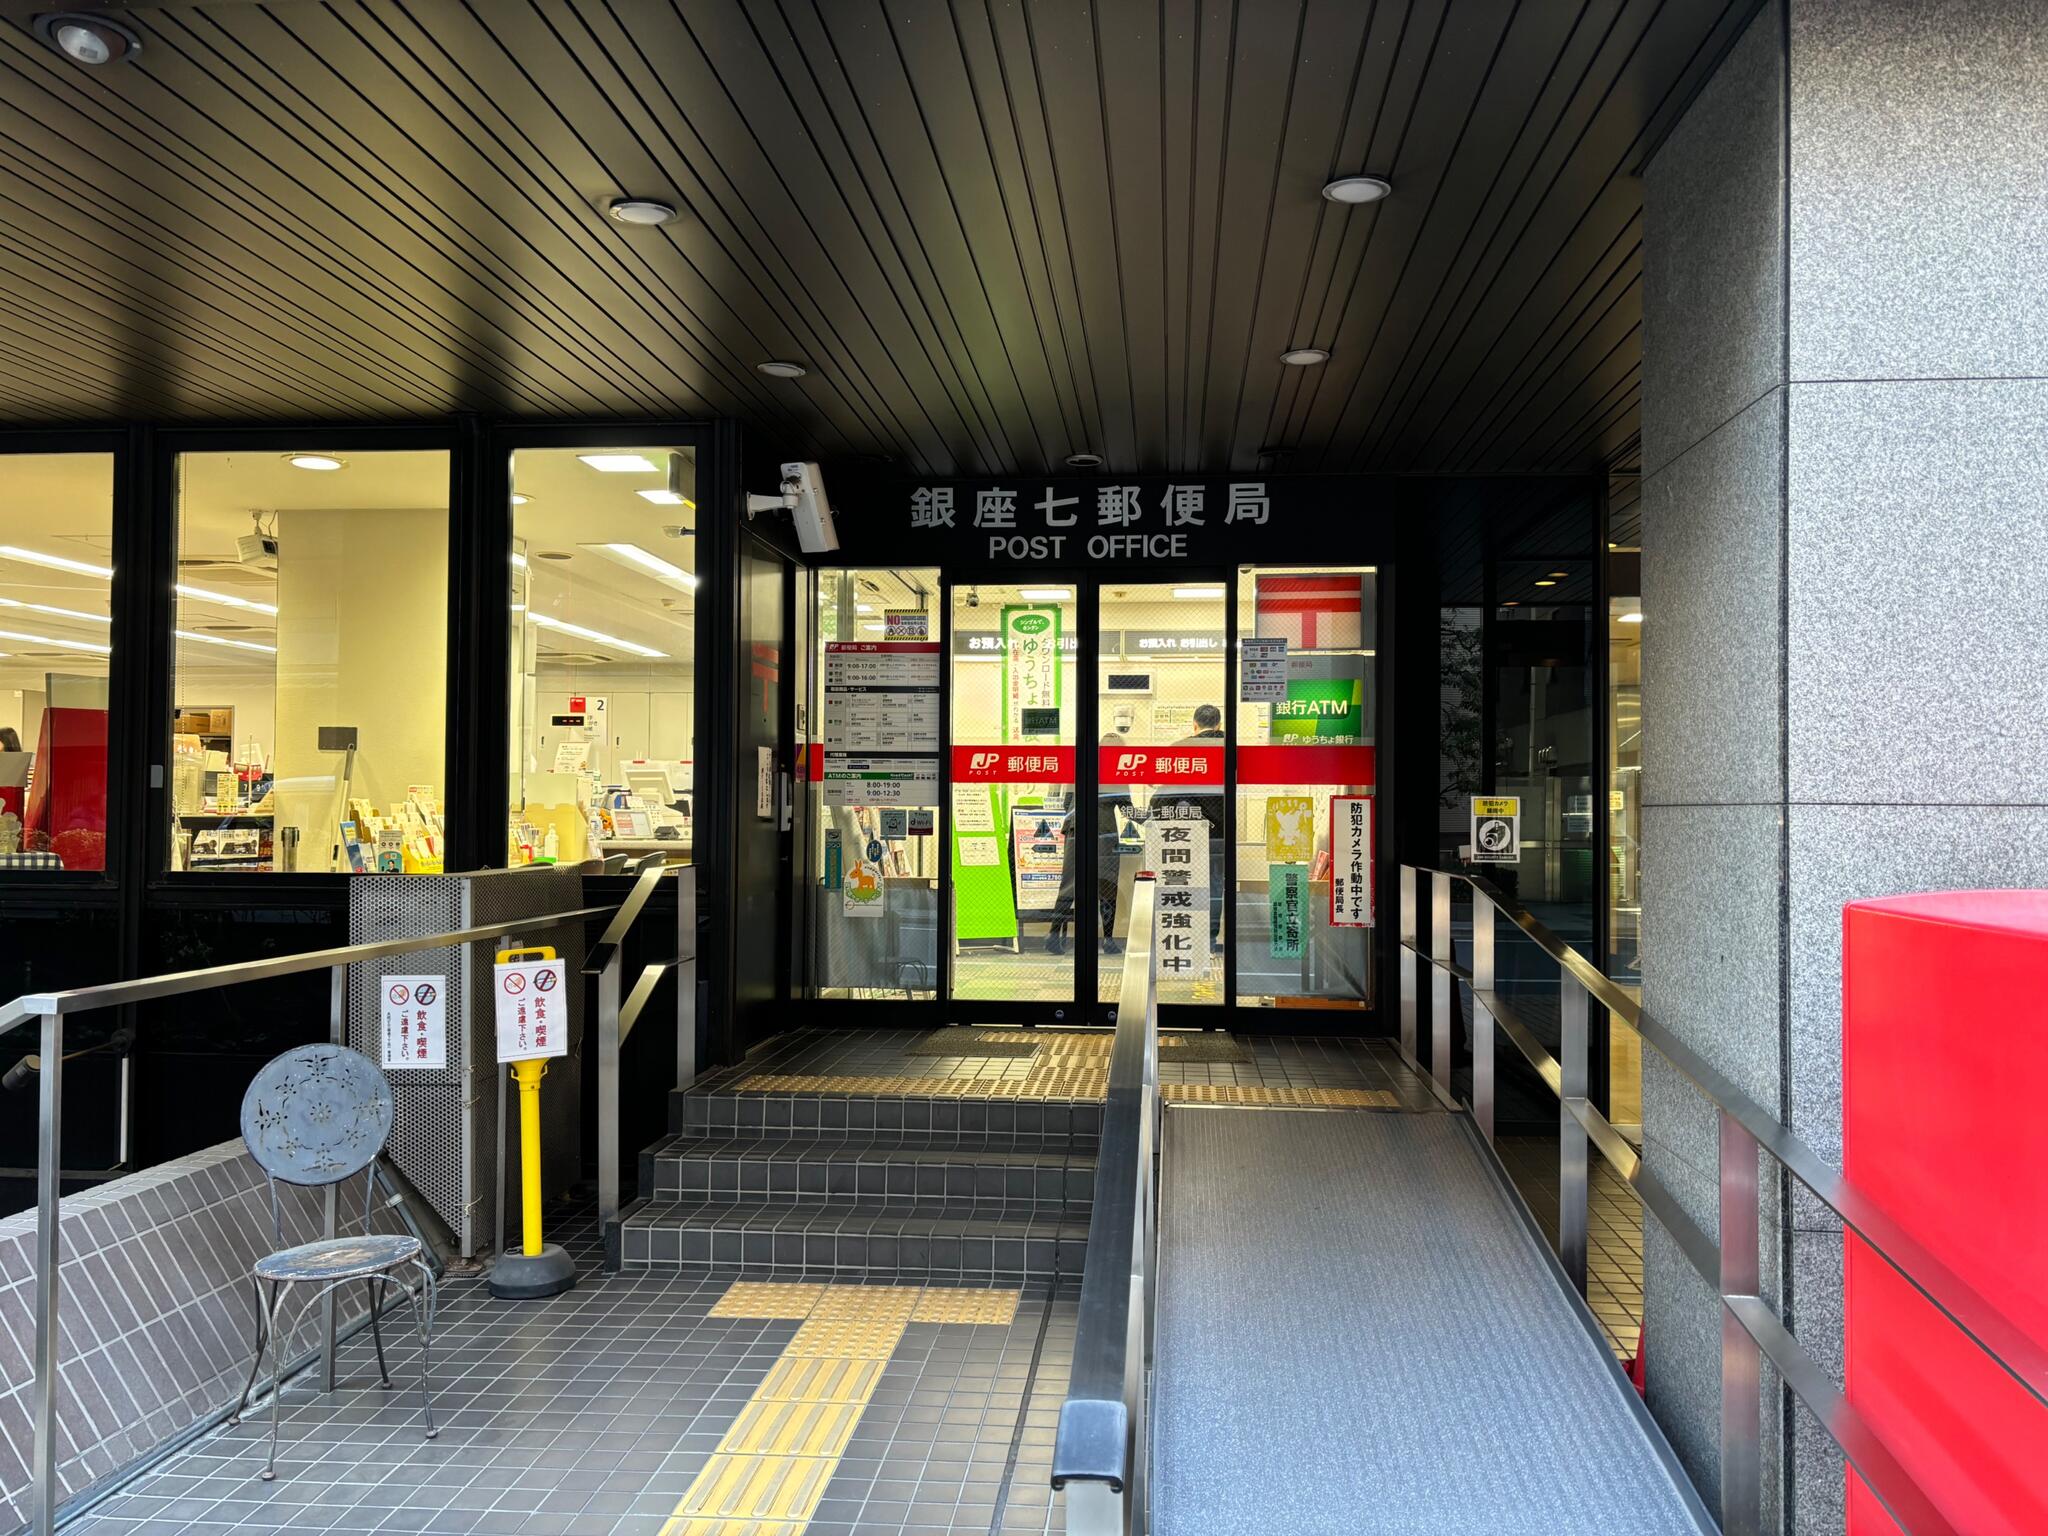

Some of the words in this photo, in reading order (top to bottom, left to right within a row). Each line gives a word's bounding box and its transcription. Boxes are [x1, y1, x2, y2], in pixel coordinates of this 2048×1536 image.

[910, 482, 1271, 529] 銀座七郵便局
[989, 536, 1066, 560] POST
[1087, 533, 1188, 558] OFFICE
[887, 615, 901, 625] NO
[597, 700, 605, 711] 2
[1276, 700, 1348, 715] 銀行ATM
[1302, 735, 1355, 745] ゆうちょ銀行
[1007, 756, 1059, 773] 郵便局
[1155, 756, 1208, 774] 郵便局
[1120, 805, 1203, 820] 銀座七郵便局
[1350, 802, 1364, 920] 防犯カメラ作動中です
[1161, 827, 1193, 973] 夜間警戒強化中
[1285, 873, 1300, 952] 警察官立寄所
[1335, 878, 1345, 914] 郵便局長
[400, 1010, 410, 1060] ご遠慮下さい。
[416, 1010, 428, 1059] 飲食・喫煙
[517, 998, 528, 1050] ご遠慮下さい。
[534, 996, 548, 1048] 飲食・喫煙
